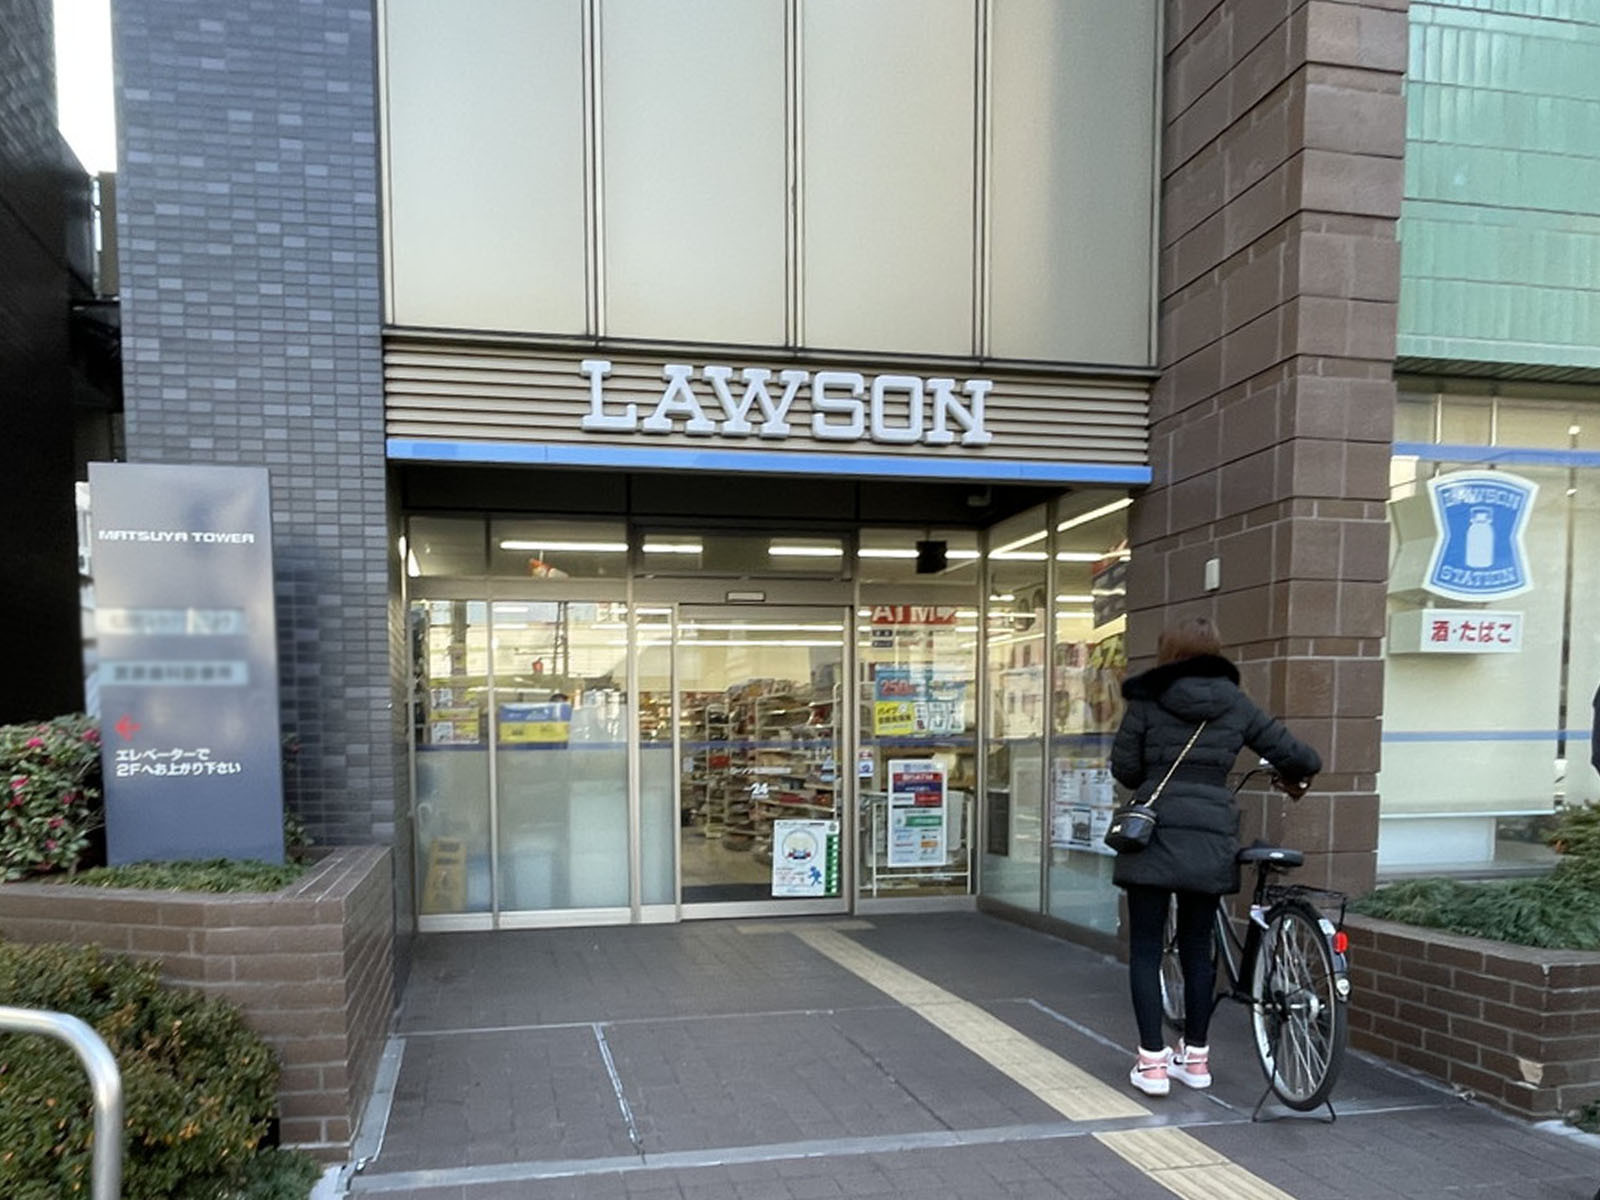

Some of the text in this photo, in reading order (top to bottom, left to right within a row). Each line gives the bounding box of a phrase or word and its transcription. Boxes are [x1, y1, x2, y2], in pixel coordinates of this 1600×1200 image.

[580, 359, 993, 447] LAWSON
[98, 529, 255, 544] MATSUYA TOWER
[1431, 620, 1513, 643] 酒・たばこ
[116, 748, 211, 761] エレベーターで
[116, 761, 242, 777] 2Fへお上がり下さい
